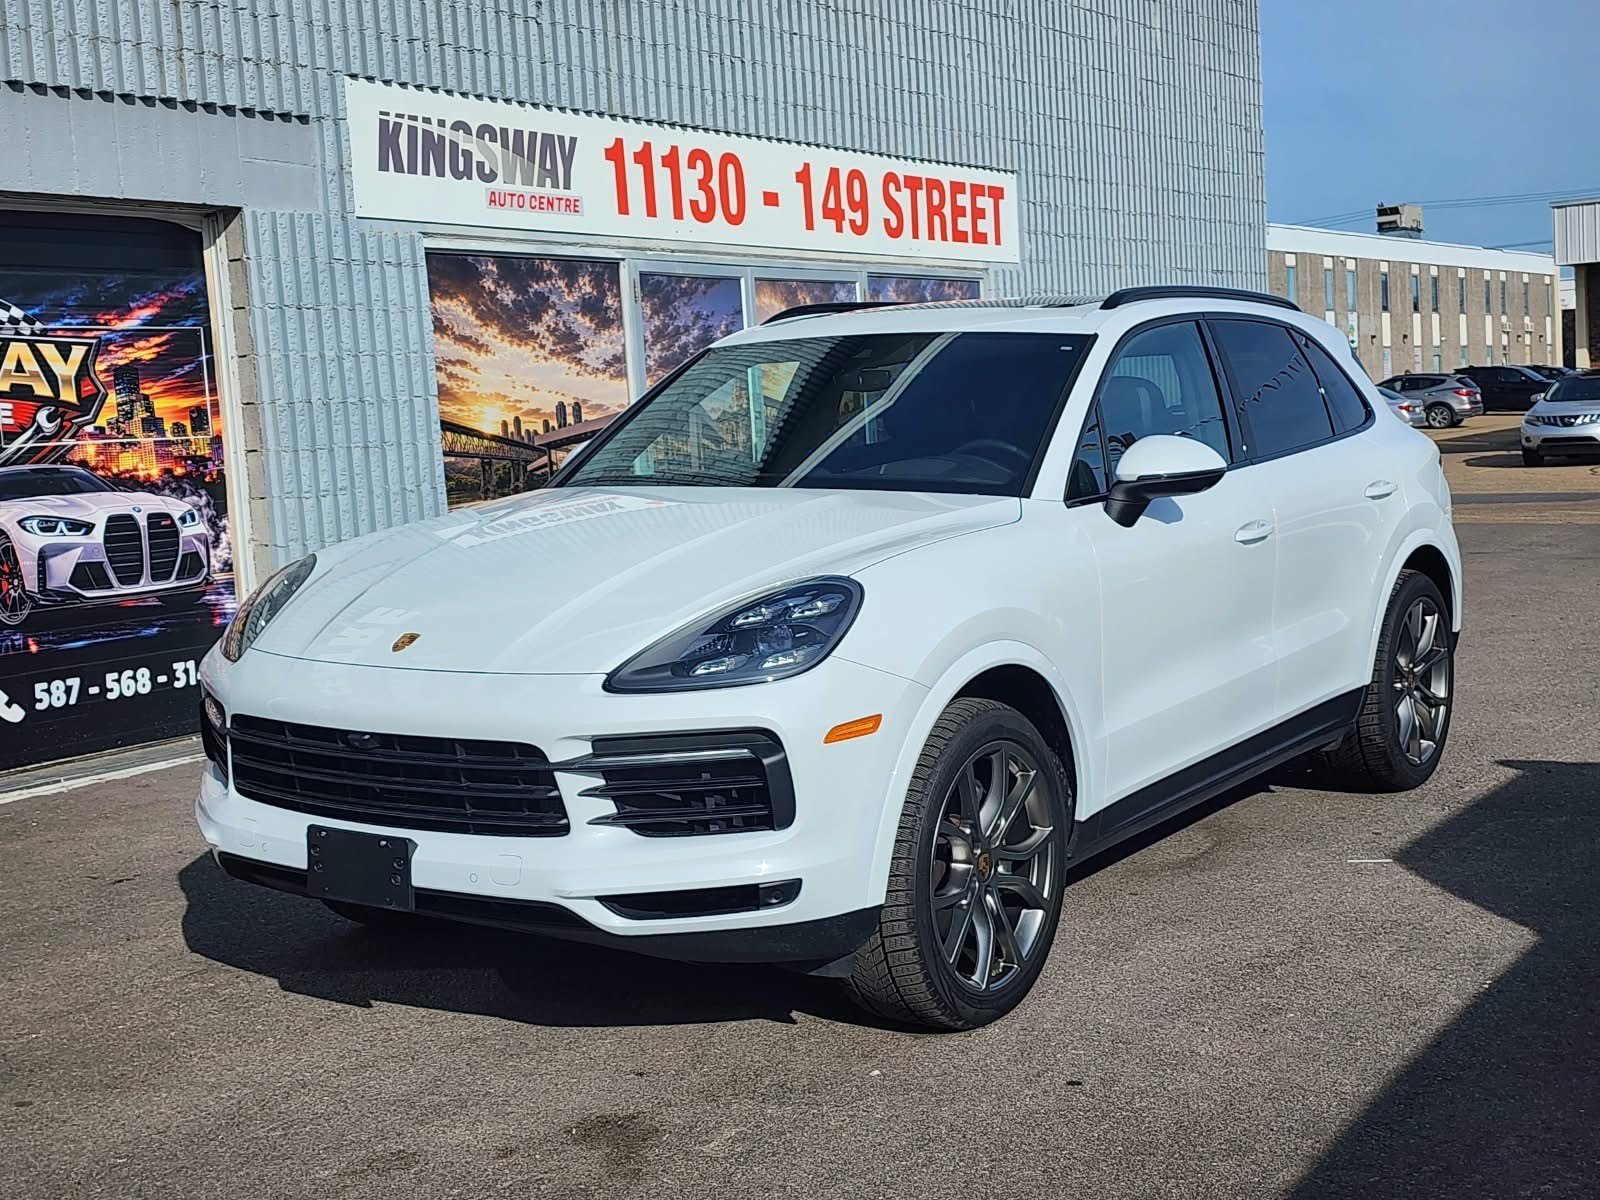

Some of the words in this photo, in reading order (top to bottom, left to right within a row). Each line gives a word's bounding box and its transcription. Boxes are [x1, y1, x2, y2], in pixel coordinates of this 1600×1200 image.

[377, 110, 578, 190] KINGSWAY
[488, 191, 526, 209] AUTO
[529, 195, 581, 214] CENTRE
[604, 137, 747, 226] 11130
[795, 162, 869, 236] 149
[882, 171, 1005, 246] STREET
[0, 341, 88, 405] AY
[34, 677, 81, 711] 587
[105, 667, 152, 700] 568
[172, 660, 201, 689] 31
